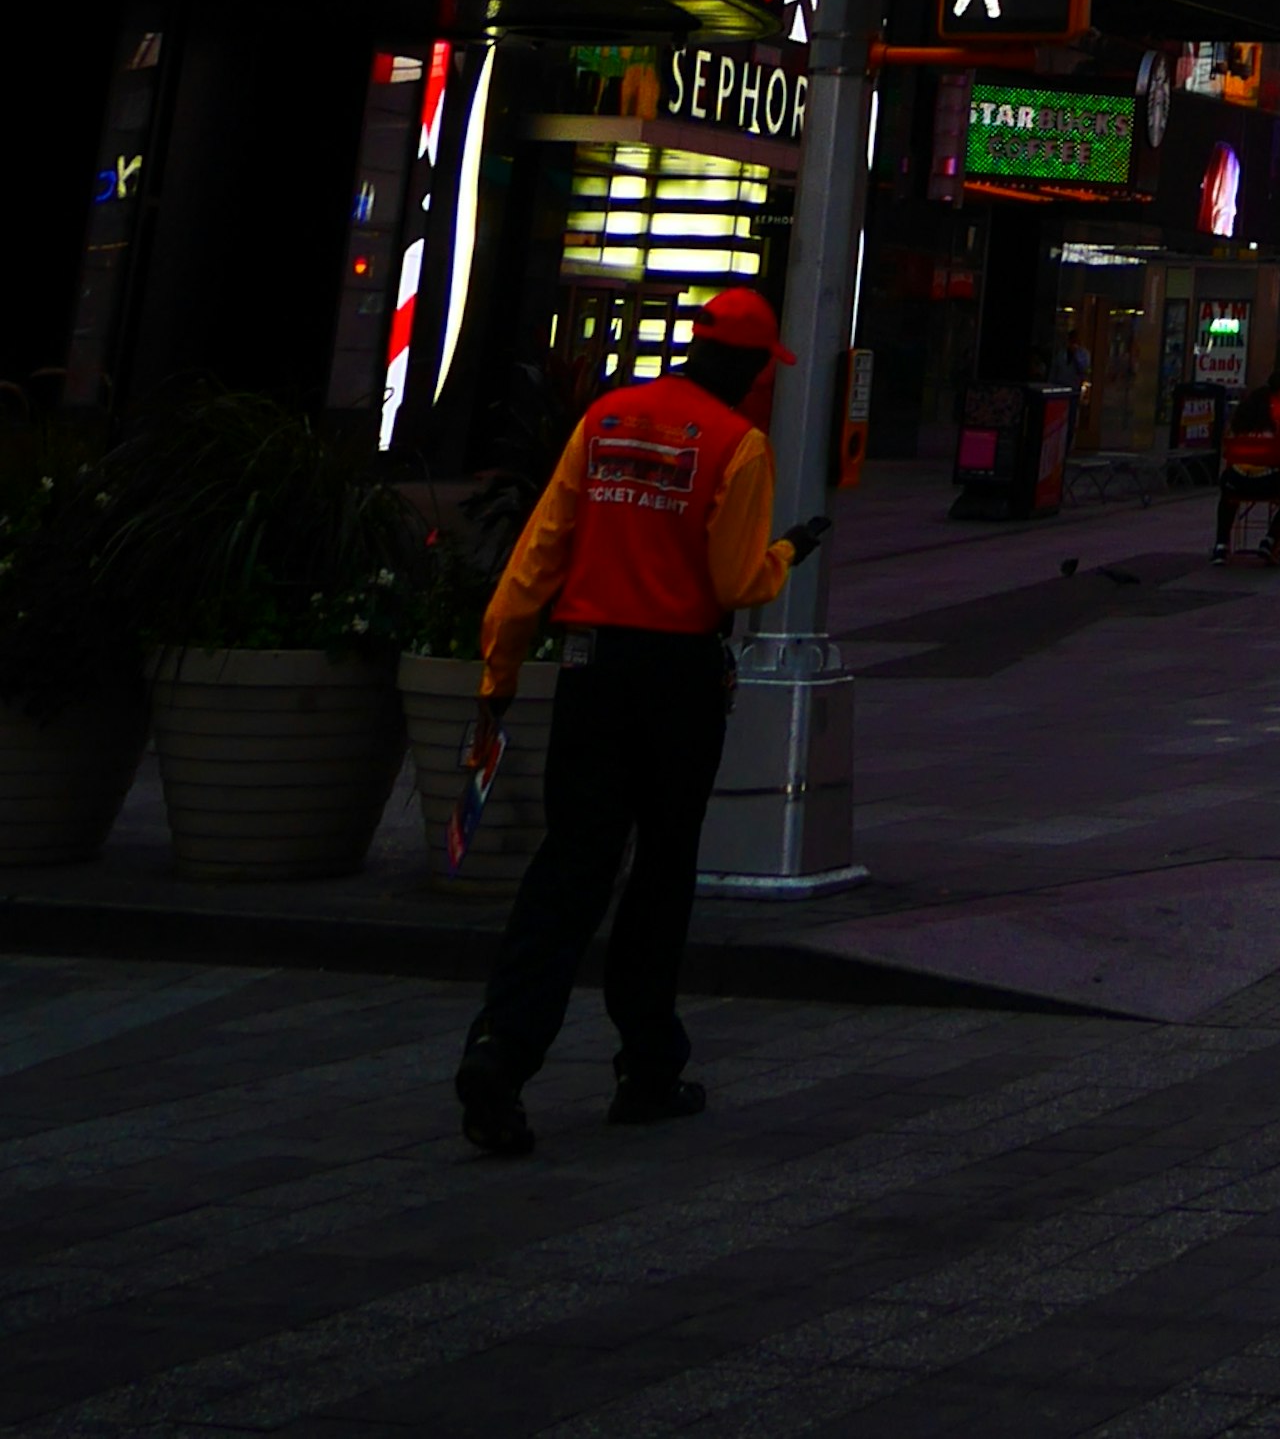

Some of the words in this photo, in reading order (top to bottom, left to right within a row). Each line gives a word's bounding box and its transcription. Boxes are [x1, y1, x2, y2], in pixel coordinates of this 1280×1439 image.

[970, 101, 1129, 136] STARBUCKS
[988, 135, 1092, 165] COFFEE
[1199, 353, 1242, 373] Candy
